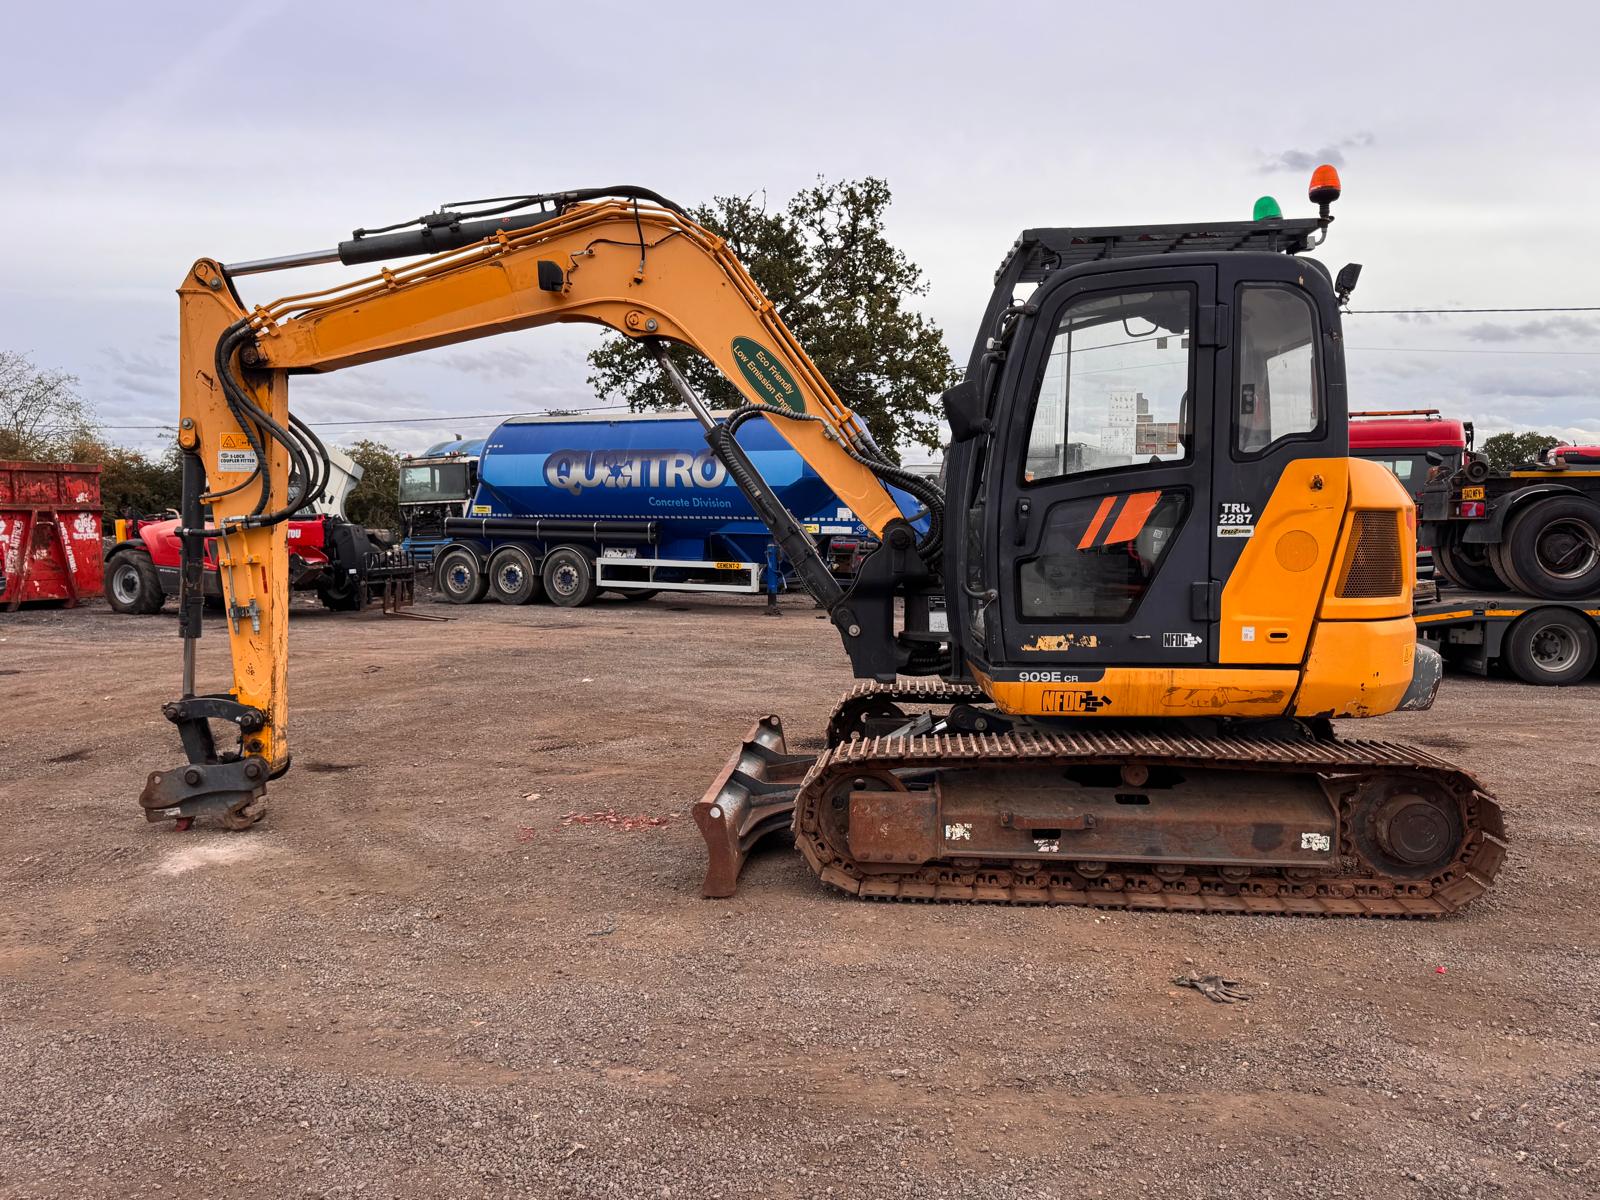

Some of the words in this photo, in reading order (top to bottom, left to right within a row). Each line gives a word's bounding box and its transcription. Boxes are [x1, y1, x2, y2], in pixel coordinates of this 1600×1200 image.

[733, 345, 748, 362] Low
[747, 361, 775, 393] Emission
[774, 392, 794, 413] Engi
[756, 351, 769, 366] Eco
[769, 365, 794, 394] Friendly
[545, 452, 727, 496] QUATTRO
[649, 497, 690, 507] Concrete
[692, 497, 732, 508] Division
[1222, 503, 1250, 513] TRU
[1219, 514, 1252, 524] 2287
[1163, 633, 1188, 647] NFDC
[1019, 672, 1061, 683] 909E
[1042, 690, 1087, 712] NFDC
